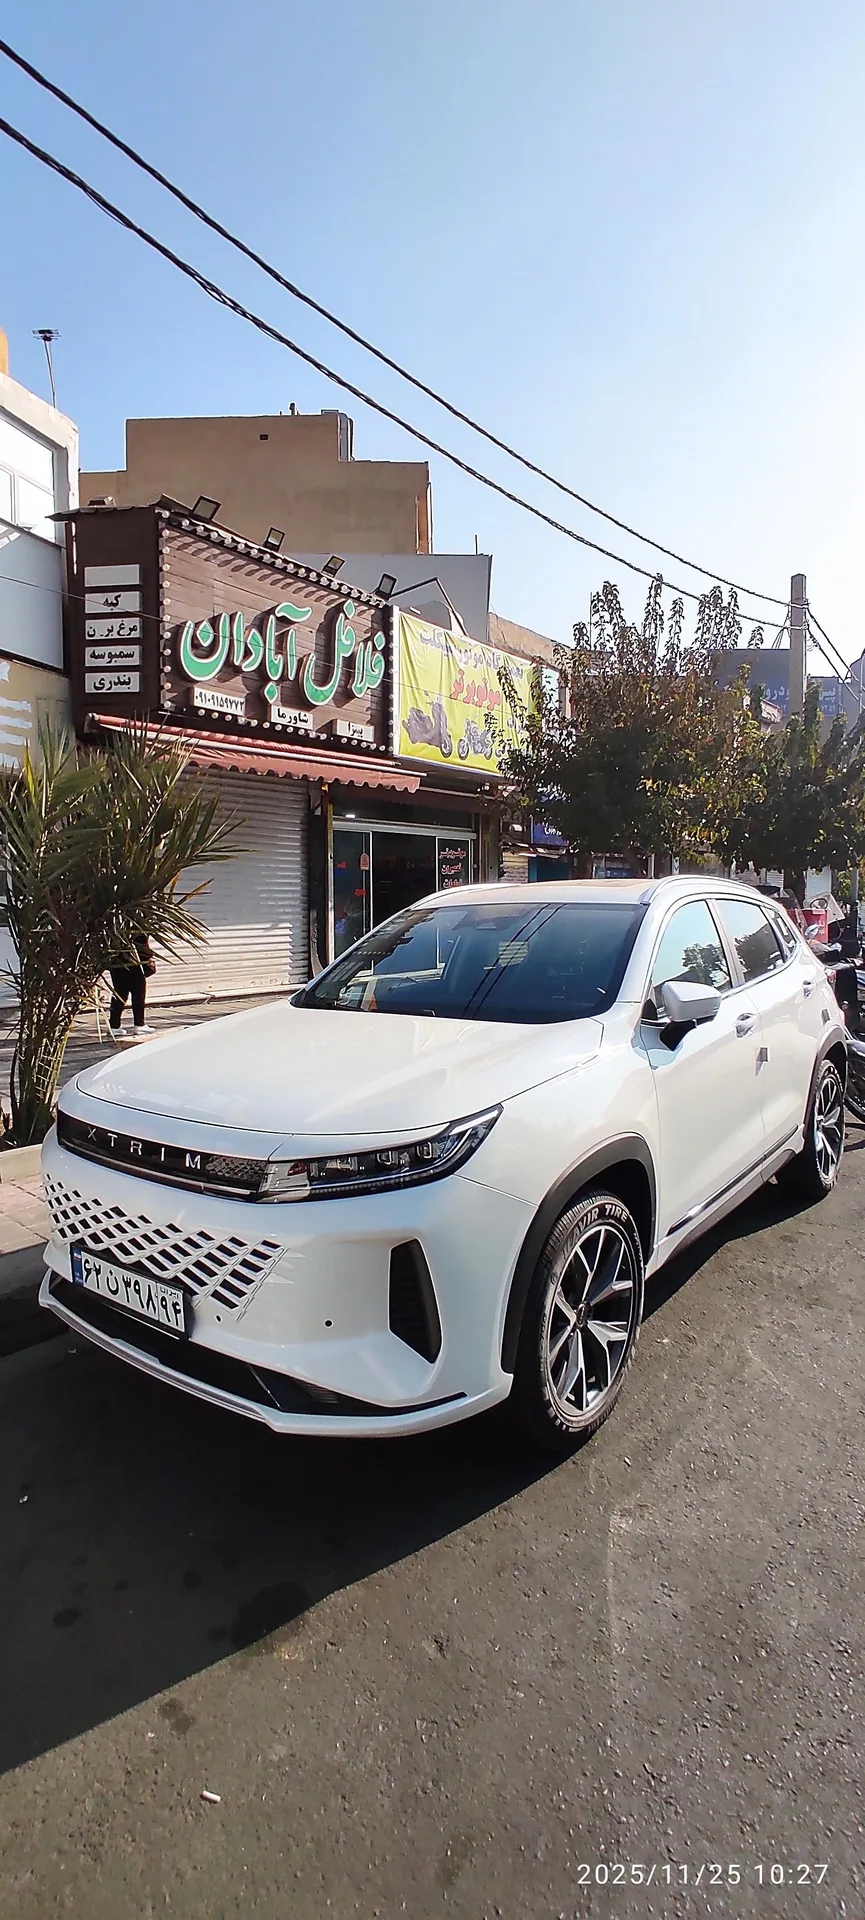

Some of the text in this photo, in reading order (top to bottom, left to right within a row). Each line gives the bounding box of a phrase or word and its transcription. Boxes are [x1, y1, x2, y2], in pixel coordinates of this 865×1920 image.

[116, 620, 138, 636] مرغ
[89, 649, 135, 664] سمبوسه
[179, 599, 386, 707] فلافل آبادان
[93, 674, 132, 691] بندری
[276, 707, 309, 725] شاورما
[86, 1125, 202, 1170] XTRIM
[604, 1204, 629, 1223] TIRE
[159, 1295, 182, 1327] ۹۴
